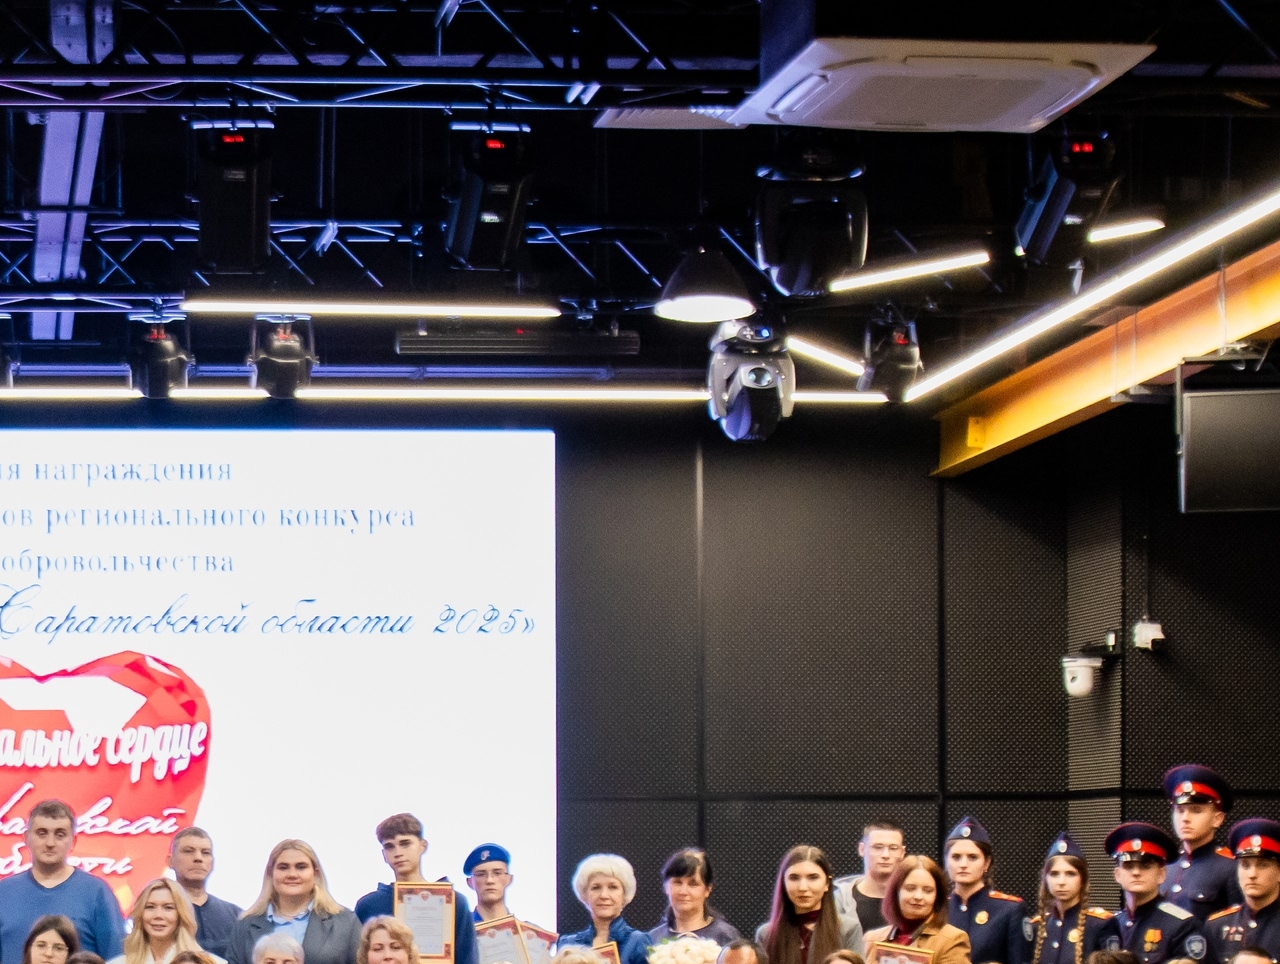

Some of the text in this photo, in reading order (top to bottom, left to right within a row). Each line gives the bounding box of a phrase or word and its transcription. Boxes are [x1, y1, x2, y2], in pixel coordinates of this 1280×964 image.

[34, 463, 232, 488] награждения
[45, 508, 267, 535] регионального
[279, 508, 416, 535] конкурса
[260, 597, 417, 636] области
[431, 603, 537, 636] 2025»
[104, 720, 209, 784] сердце
